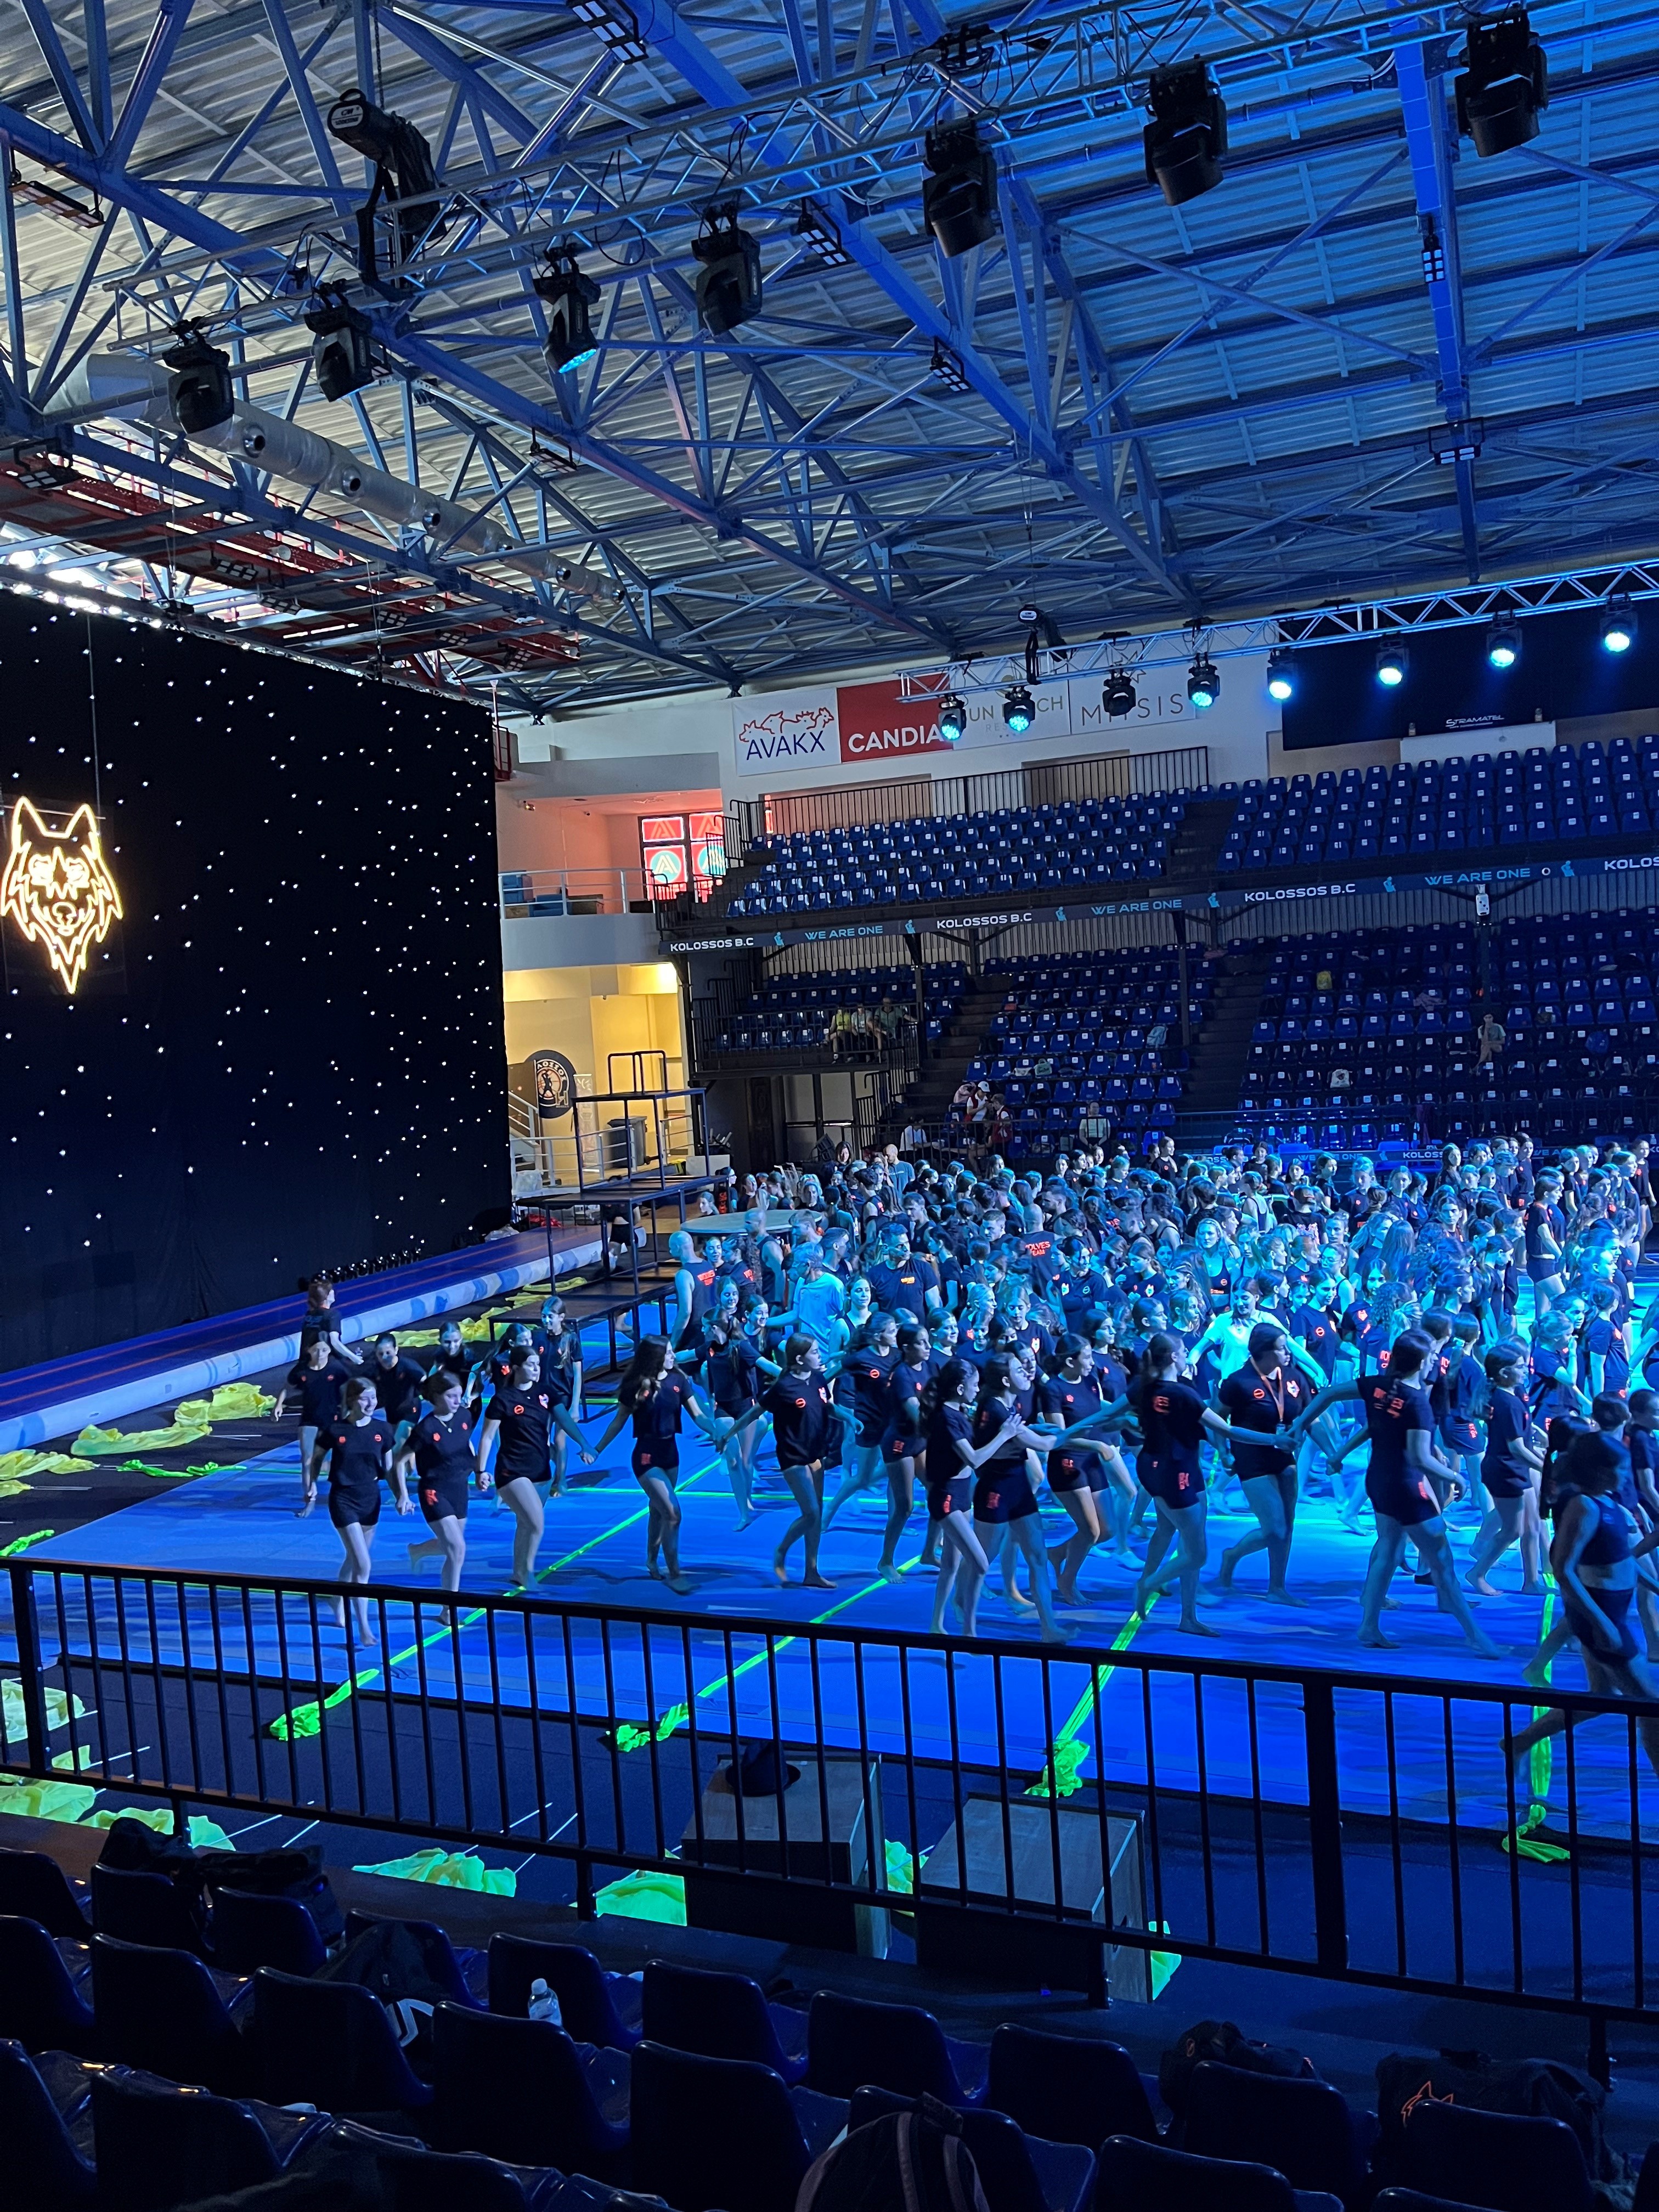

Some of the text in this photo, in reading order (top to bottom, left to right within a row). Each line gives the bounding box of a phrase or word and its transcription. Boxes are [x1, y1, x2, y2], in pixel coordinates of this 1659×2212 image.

[1082, 693, 1183, 726] MSIS
[1446, 715, 1504, 727] STRAMATEL
[746, 730, 826, 760] AVAKX
[848, 724, 943, 753] CANDIA
[1425, 868, 1531, 885] WE ARE ONE
[1245, 883, 1356, 901] KOLOSSOS B.C
[1091, 899, 1182, 915] WE ARE ONE
[936, 913, 1032, 929] KOLOSSOS B.C
[805, 926, 883, 940] WE ARE ONE
[670, 938, 754, 952] KOLOSSOS B.C
